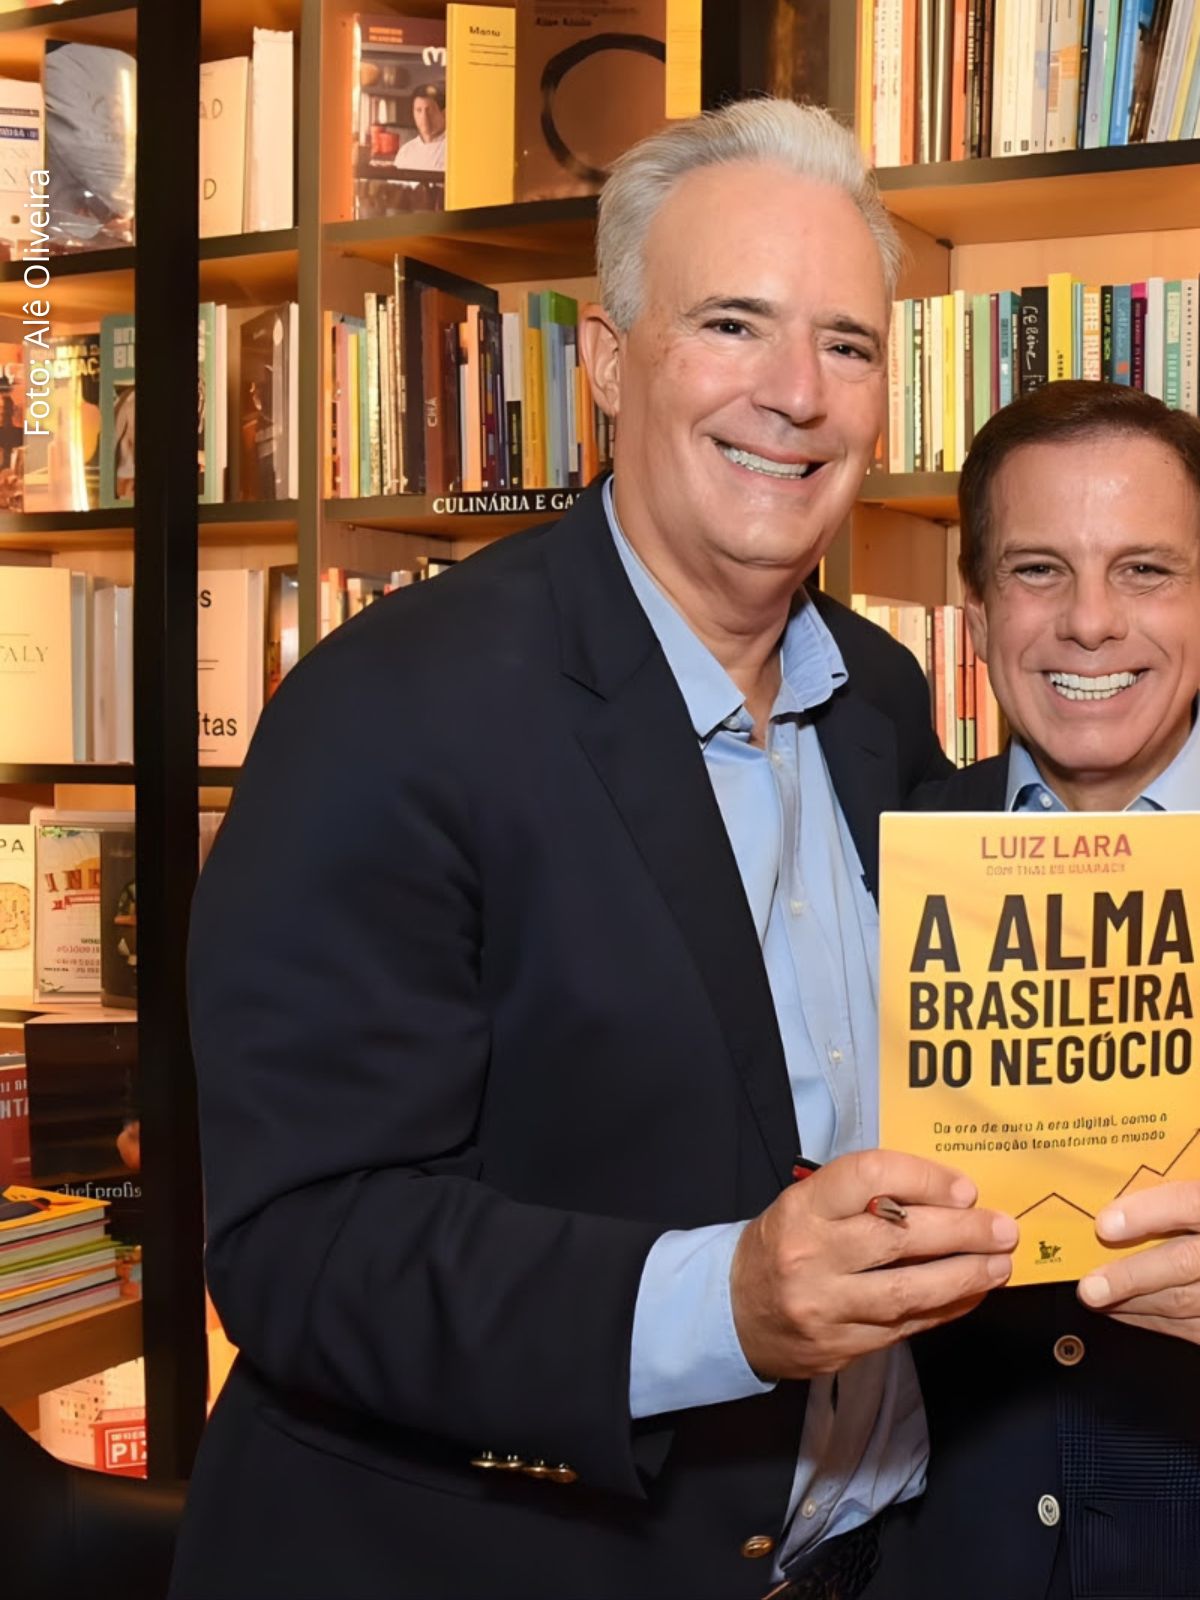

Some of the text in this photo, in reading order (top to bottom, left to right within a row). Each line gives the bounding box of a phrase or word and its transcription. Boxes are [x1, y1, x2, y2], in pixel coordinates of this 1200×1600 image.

[432, 493, 530, 514] CULINÁRIA
[535, 495, 547, 510] E
[981, 833, 1132, 860] LUIZ LARA
[909, 888, 1195, 973] A ALMA
[908, 972, 1194, 1031] BRASILEIRA
[908, 1027, 1193, 1089] DO NEGÓCIO
